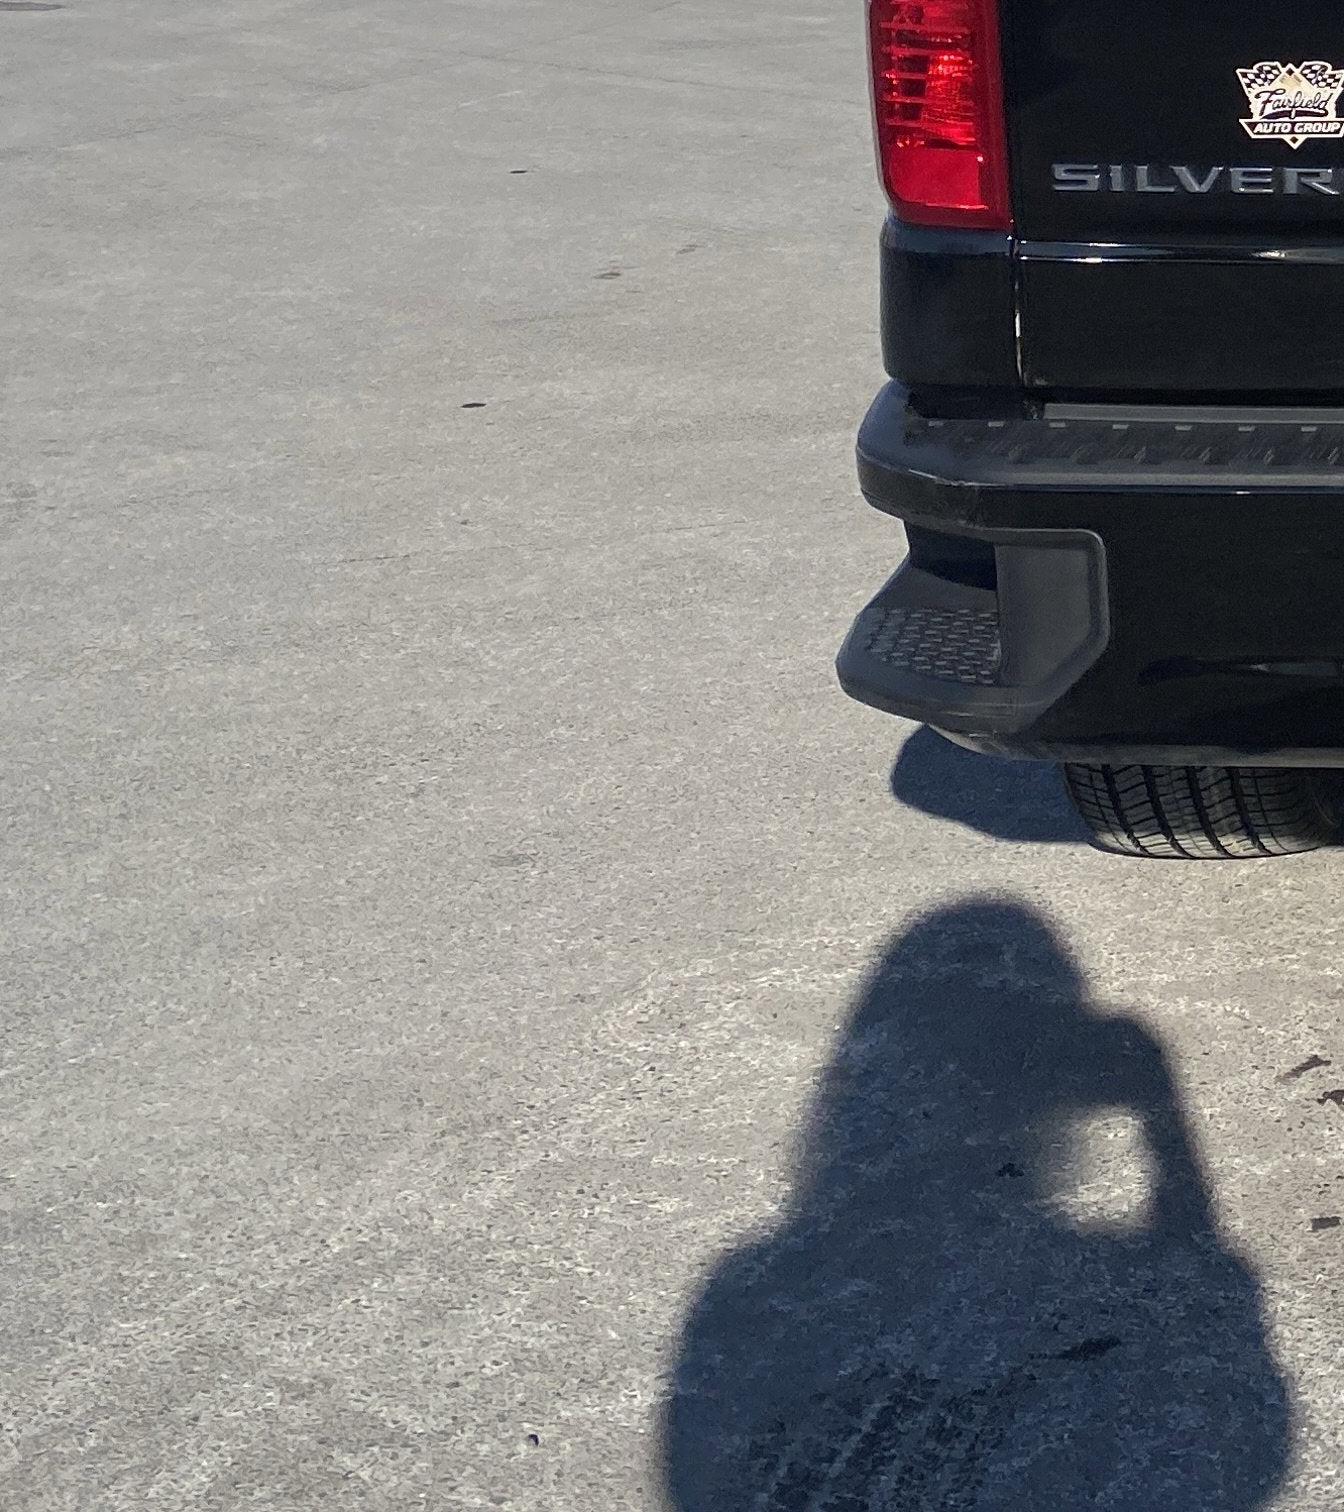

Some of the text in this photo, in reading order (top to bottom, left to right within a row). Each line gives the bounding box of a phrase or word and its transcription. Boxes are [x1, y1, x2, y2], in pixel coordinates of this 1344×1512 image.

[1254, 89, 1334, 119] Fairfield
[1253, 123, 1341, 133] AUTO GROUP
